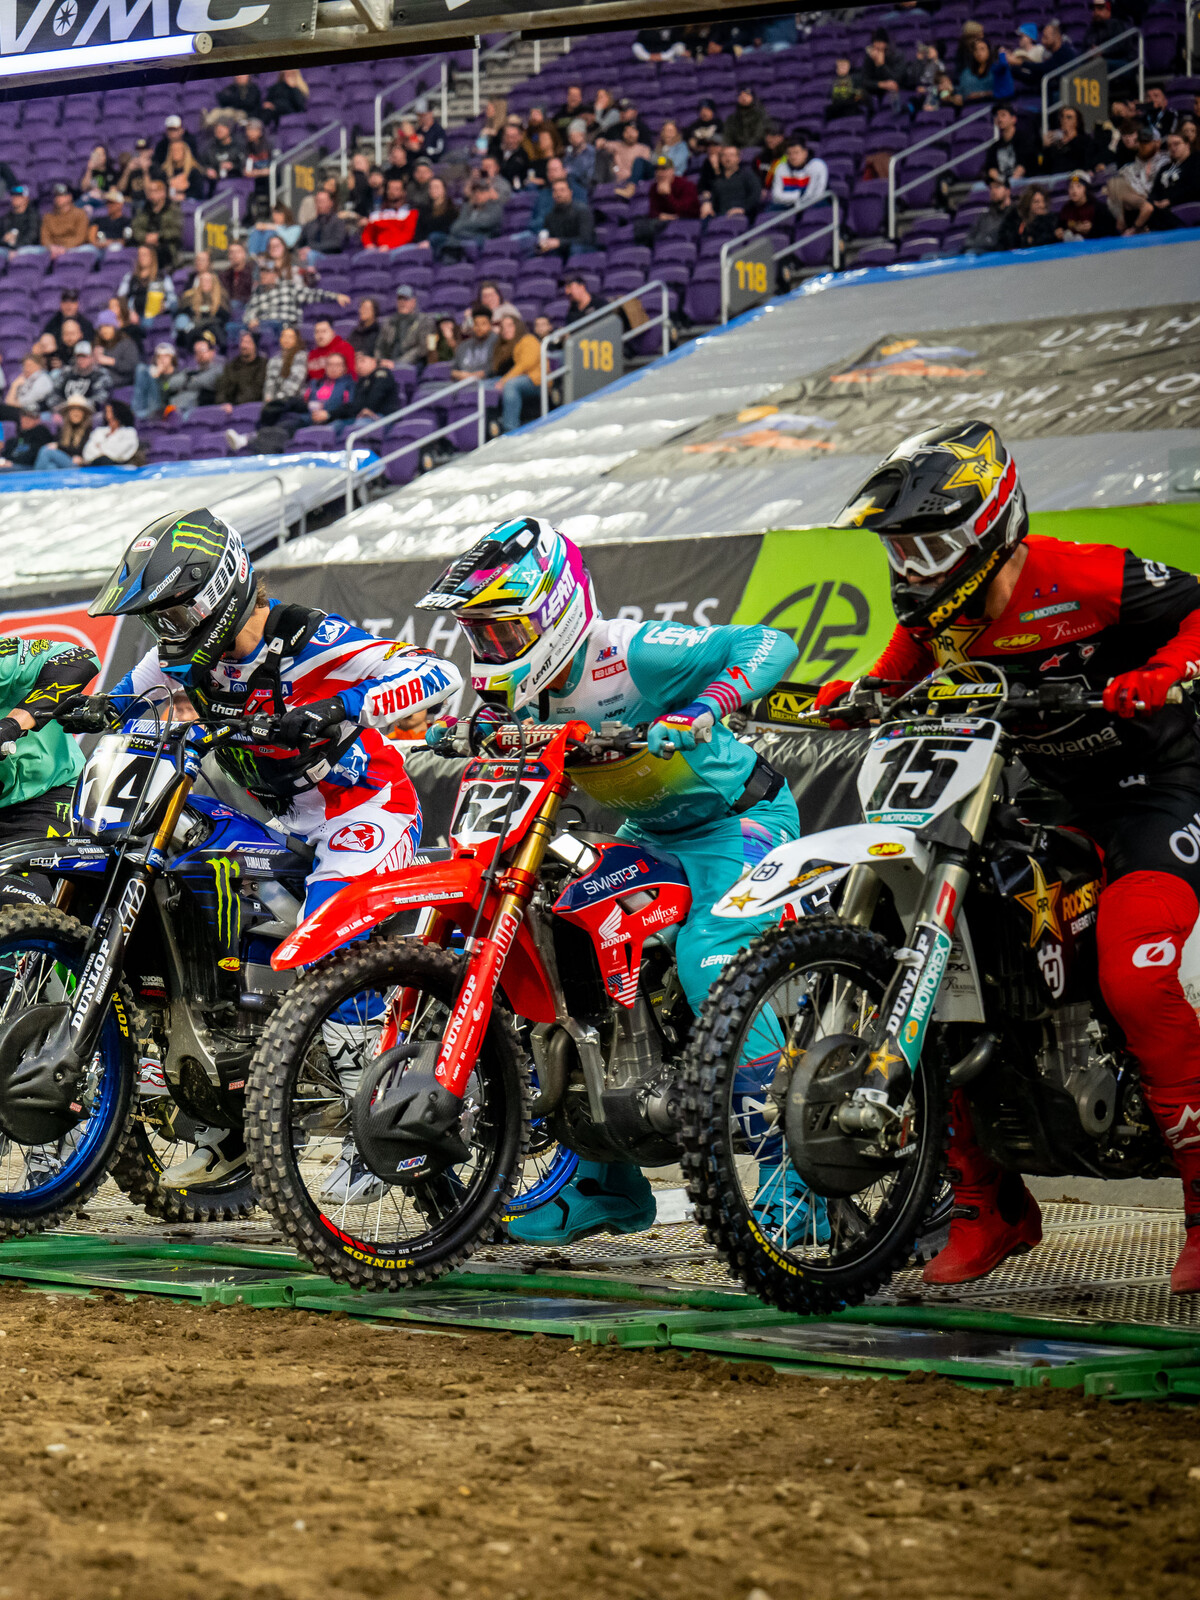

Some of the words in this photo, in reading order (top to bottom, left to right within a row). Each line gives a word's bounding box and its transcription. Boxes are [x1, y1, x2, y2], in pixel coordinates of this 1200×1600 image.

[1072, 74, 1102, 109] 118
[734, 256, 768, 294] 118
[579, 338, 615, 373] 118
[134, 540, 152, 548] BELL
[203, 531, 241, 608] 100%
[541, 561, 576, 629] LEATT
[928, 551, 1000, 628] ROCKSTAR
[204, 597, 238, 648] MONSTER
[217, 608, 238, 644] ENERGY
[1034, 602, 1078, 618] MOTOREX
[290, 625, 306, 647] thor
[532, 655, 552, 685] LEATT
[594, 667, 605, 680] RED
[615, 661, 627, 673] OIL
[211, 704, 243, 716] thor
[865, 740, 974, 811] 15
[451, 783, 531, 835] 62
[881, 814, 925, 822] MOTOREX
[244, 856, 271, 870] YAMALUBE
[583, 864, 639, 896] SMARTOP
[336, 926, 351, 938] RED
[349, 918, 365, 932] LINE
[363, 913, 375, 925] OIL
[641, 904, 678, 927] bullfrog
[600, 932, 632, 950] HONDA
[71, 939, 112, 1031] DUNLOP
[80, 952, 95, 985] CYCRA
[915, 939, 949, 1022] MOTOREX
[442, 974, 477, 1061] DUNLOP
[343, 1245, 407, 1269] DUNLOP
[747, 1220, 798, 1276] DUNLOP
